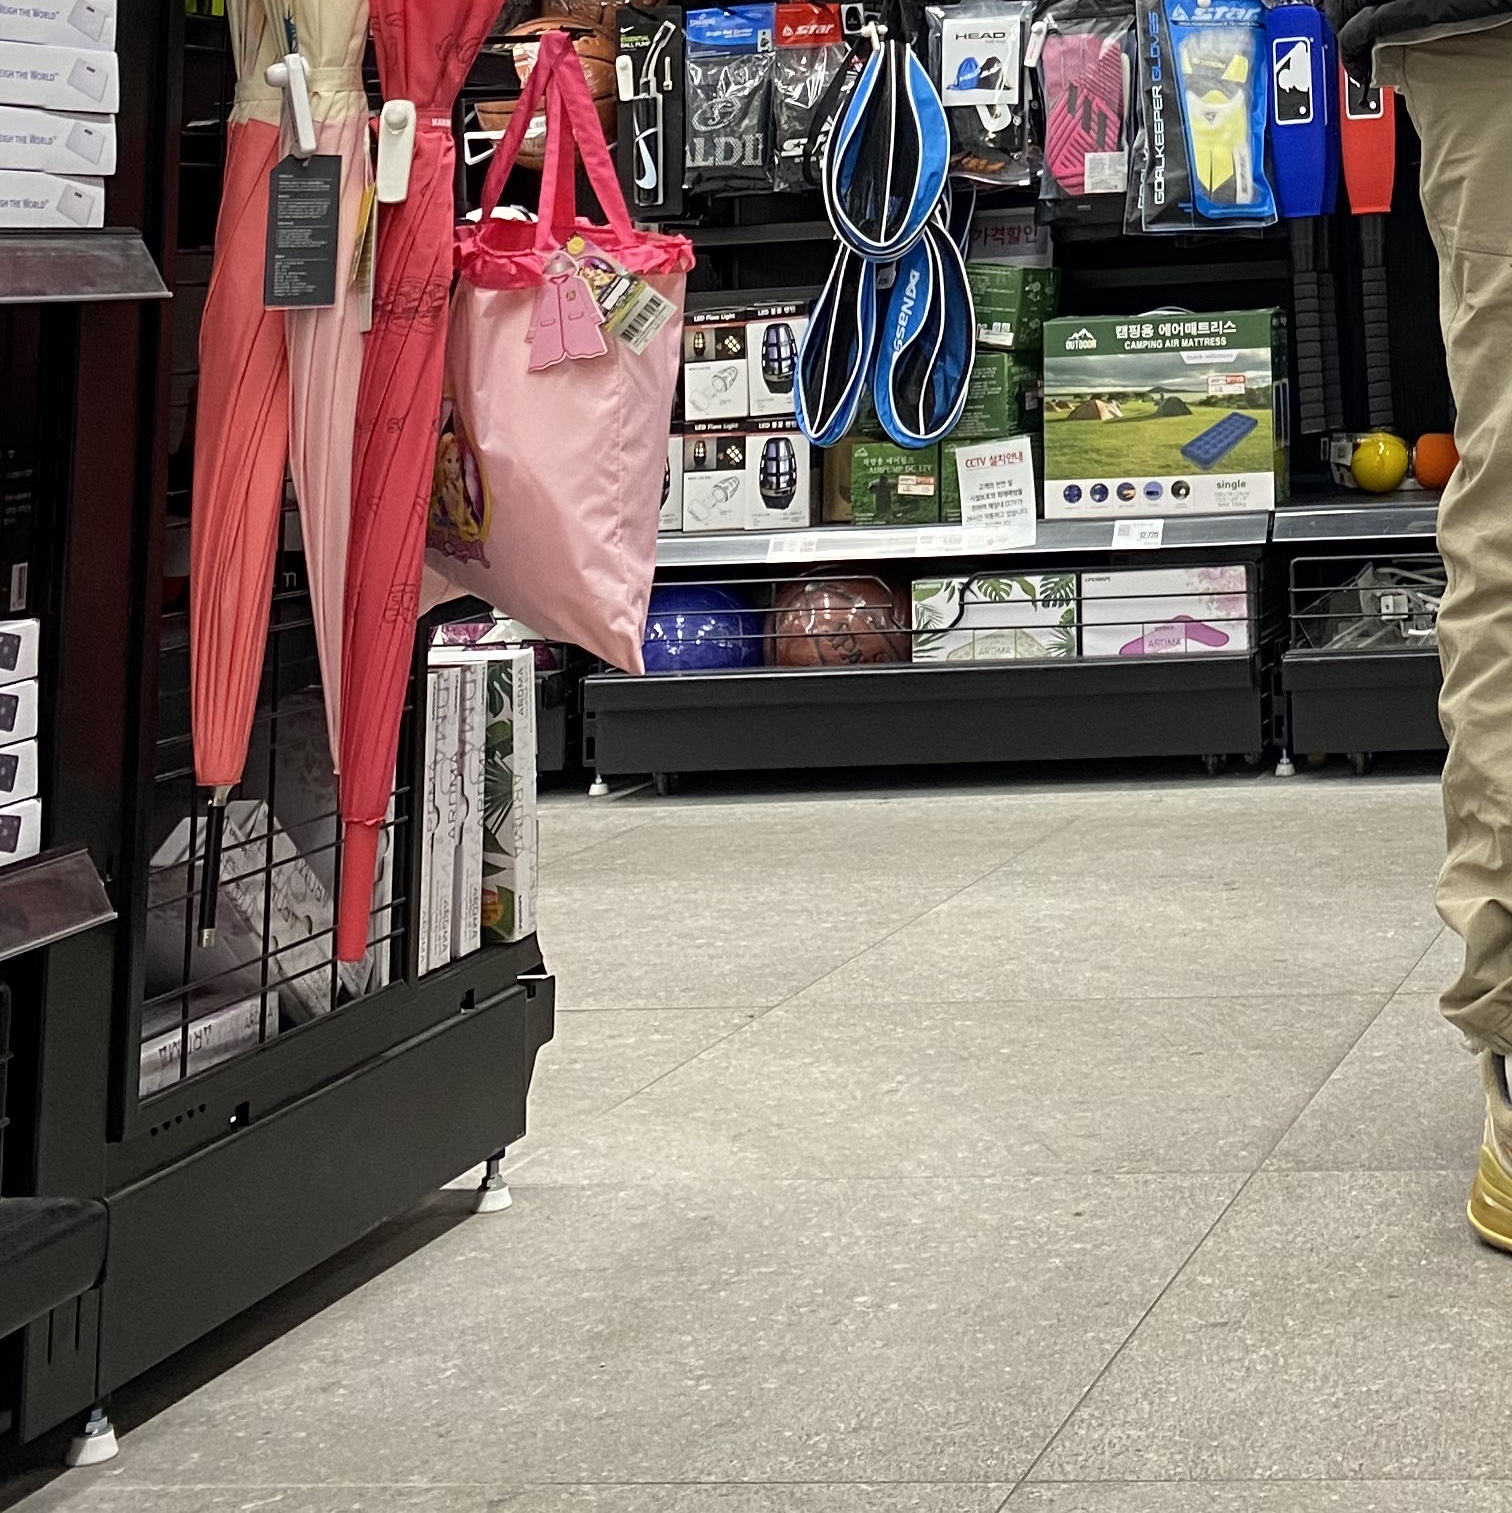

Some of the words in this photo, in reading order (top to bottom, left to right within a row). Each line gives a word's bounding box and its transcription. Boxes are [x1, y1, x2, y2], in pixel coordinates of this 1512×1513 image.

[955, 31, 1006, 41] HEAD
[1148, 11, 1161, 82] GLOVES
[1152, 84, 1165, 205] GOALKEEPER
[1115, 322, 1154, 339] 캠핑용
[1158, 320, 1237, 338] 에어매트리스
[1065, 339, 1097, 351] OUTDOOR
[1124, 339, 1163, 351] CAMPING
[1164, 338, 1180, 349] AIR
[1181, 336, 1227, 348] MATTRESS
[965, 456, 987, 469] CCTV
[1216, 480, 1247, 491] single
[1147, 638, 1182, 648] AROMA
[978, 646, 1012, 656] AROMA
[517, 666, 525, 717] AROMA
